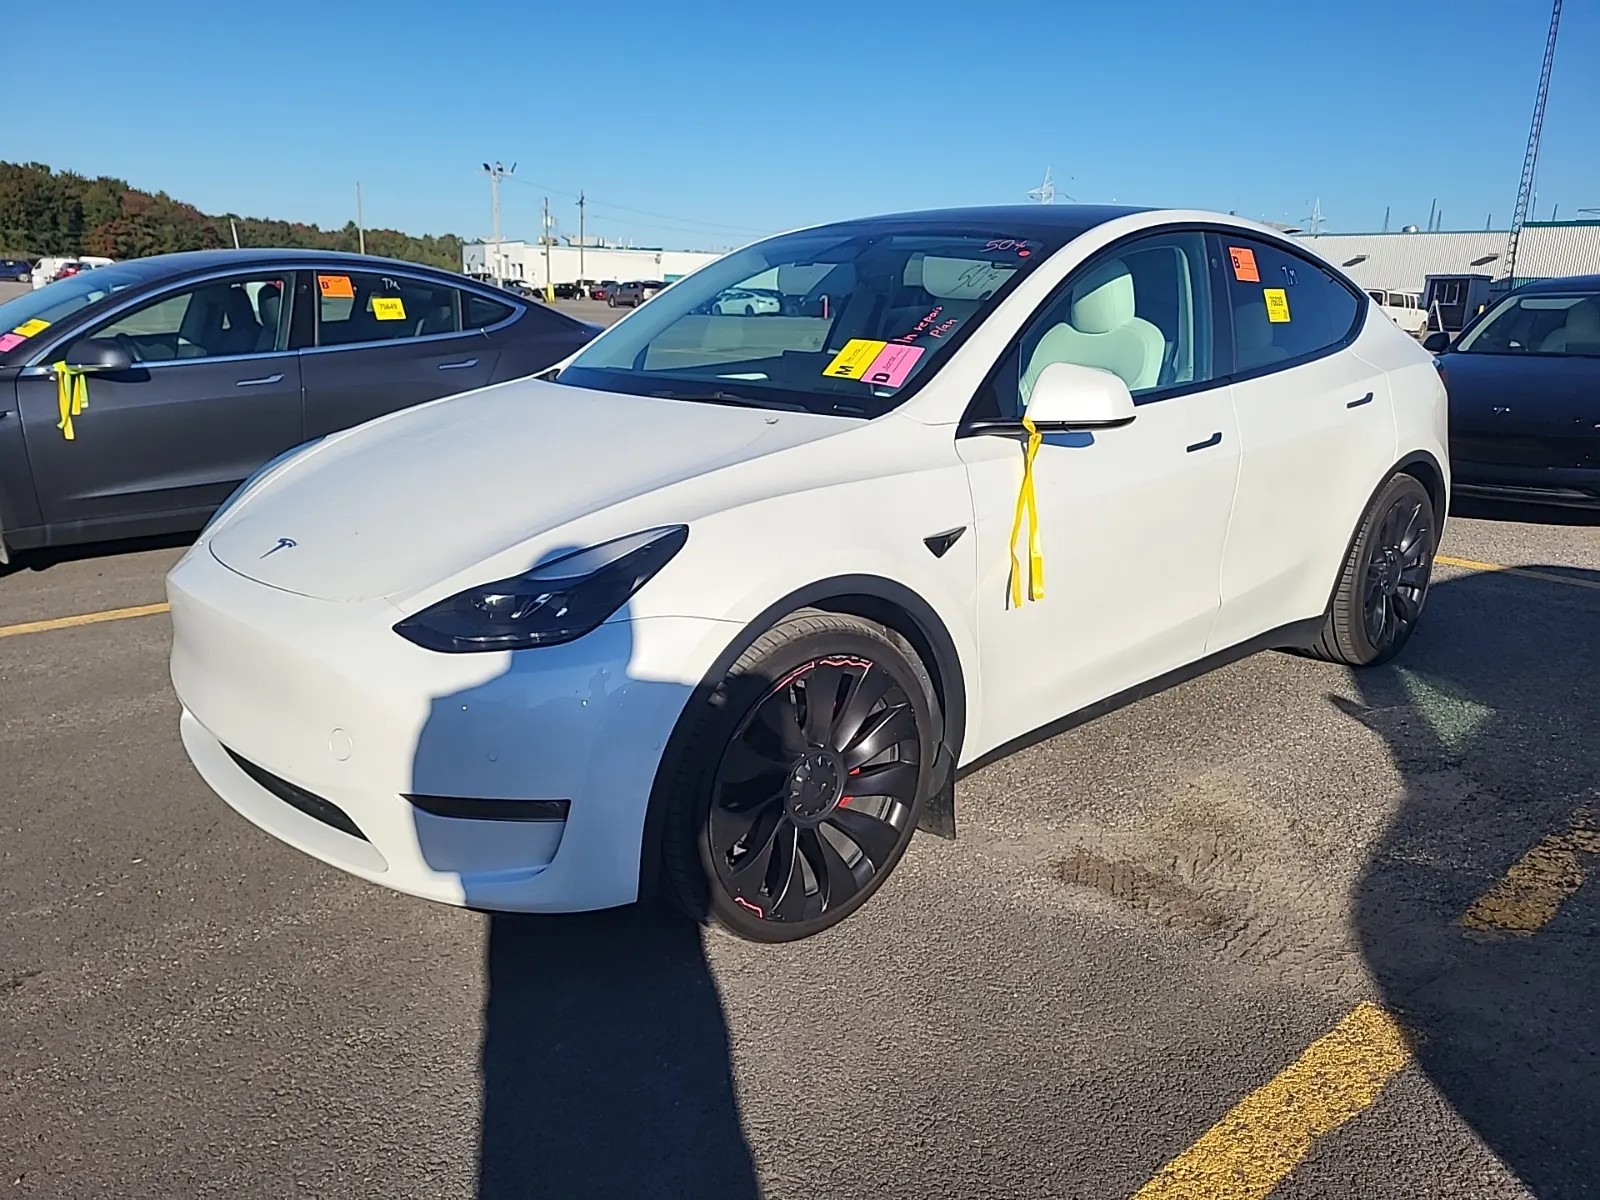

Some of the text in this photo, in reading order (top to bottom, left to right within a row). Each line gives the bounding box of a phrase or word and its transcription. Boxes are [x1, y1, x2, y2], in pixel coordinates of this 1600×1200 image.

[1232, 256, 1240, 269] B
[321, 281, 329, 289] B
[834, 365, 854, 375] M
[871, 372, 890, 383] D
